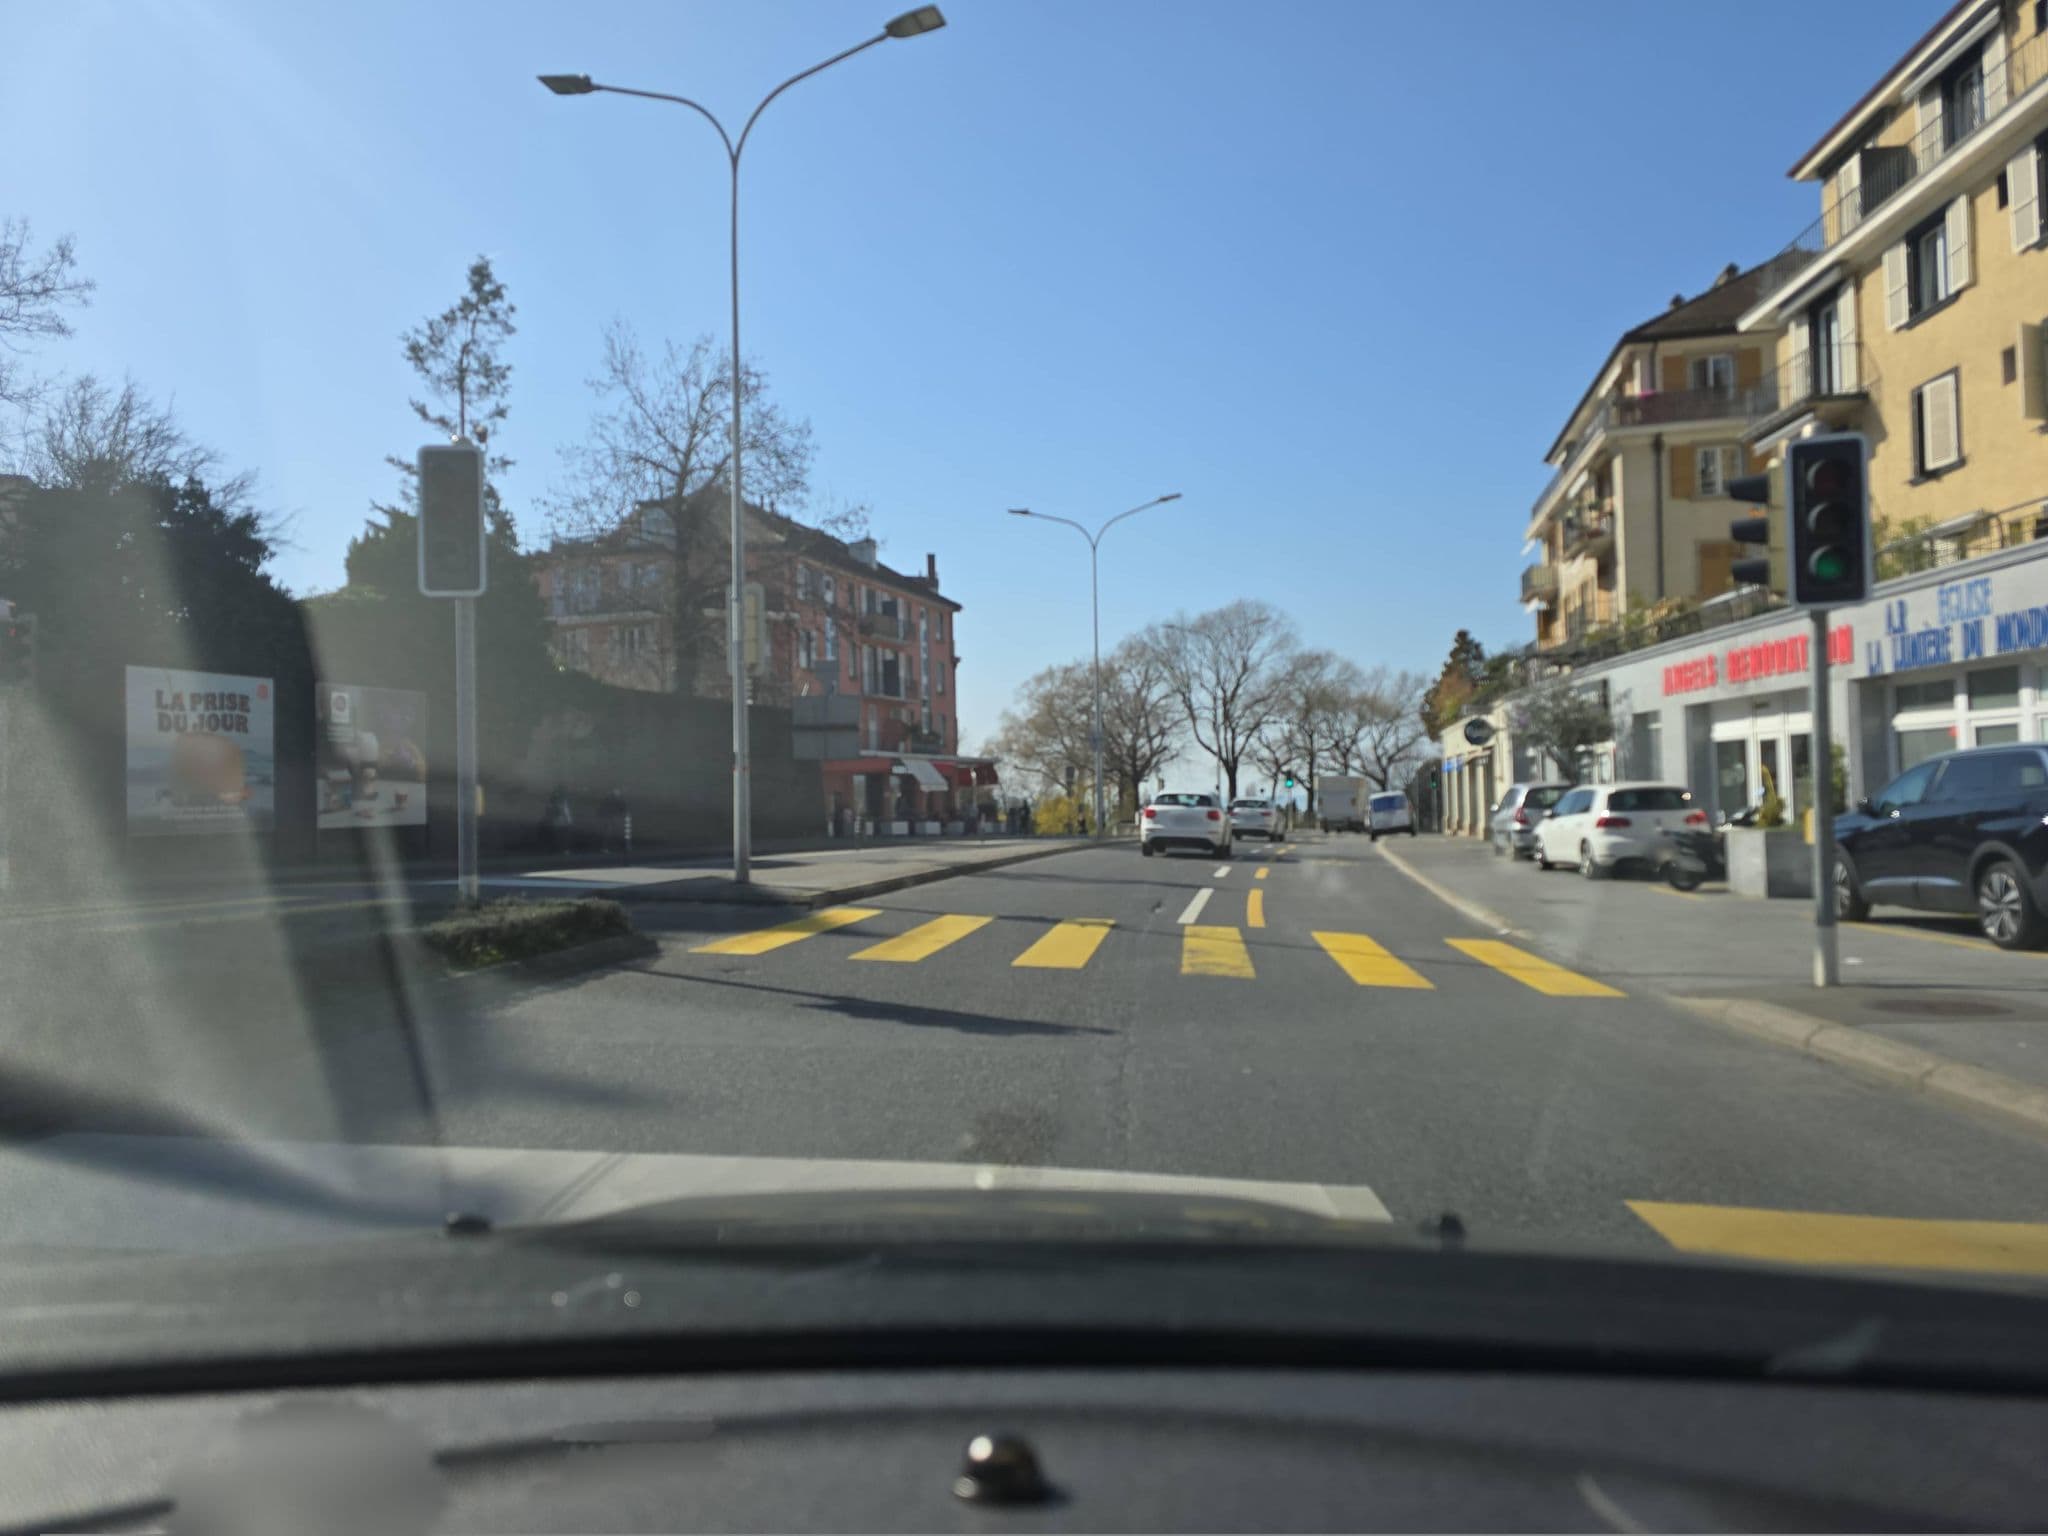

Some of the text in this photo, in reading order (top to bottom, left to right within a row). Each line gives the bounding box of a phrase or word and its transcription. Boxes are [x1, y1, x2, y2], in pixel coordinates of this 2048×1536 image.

[155, 690, 250, 712] LA PRISE
[158, 712, 249, 733] DU JOUR
